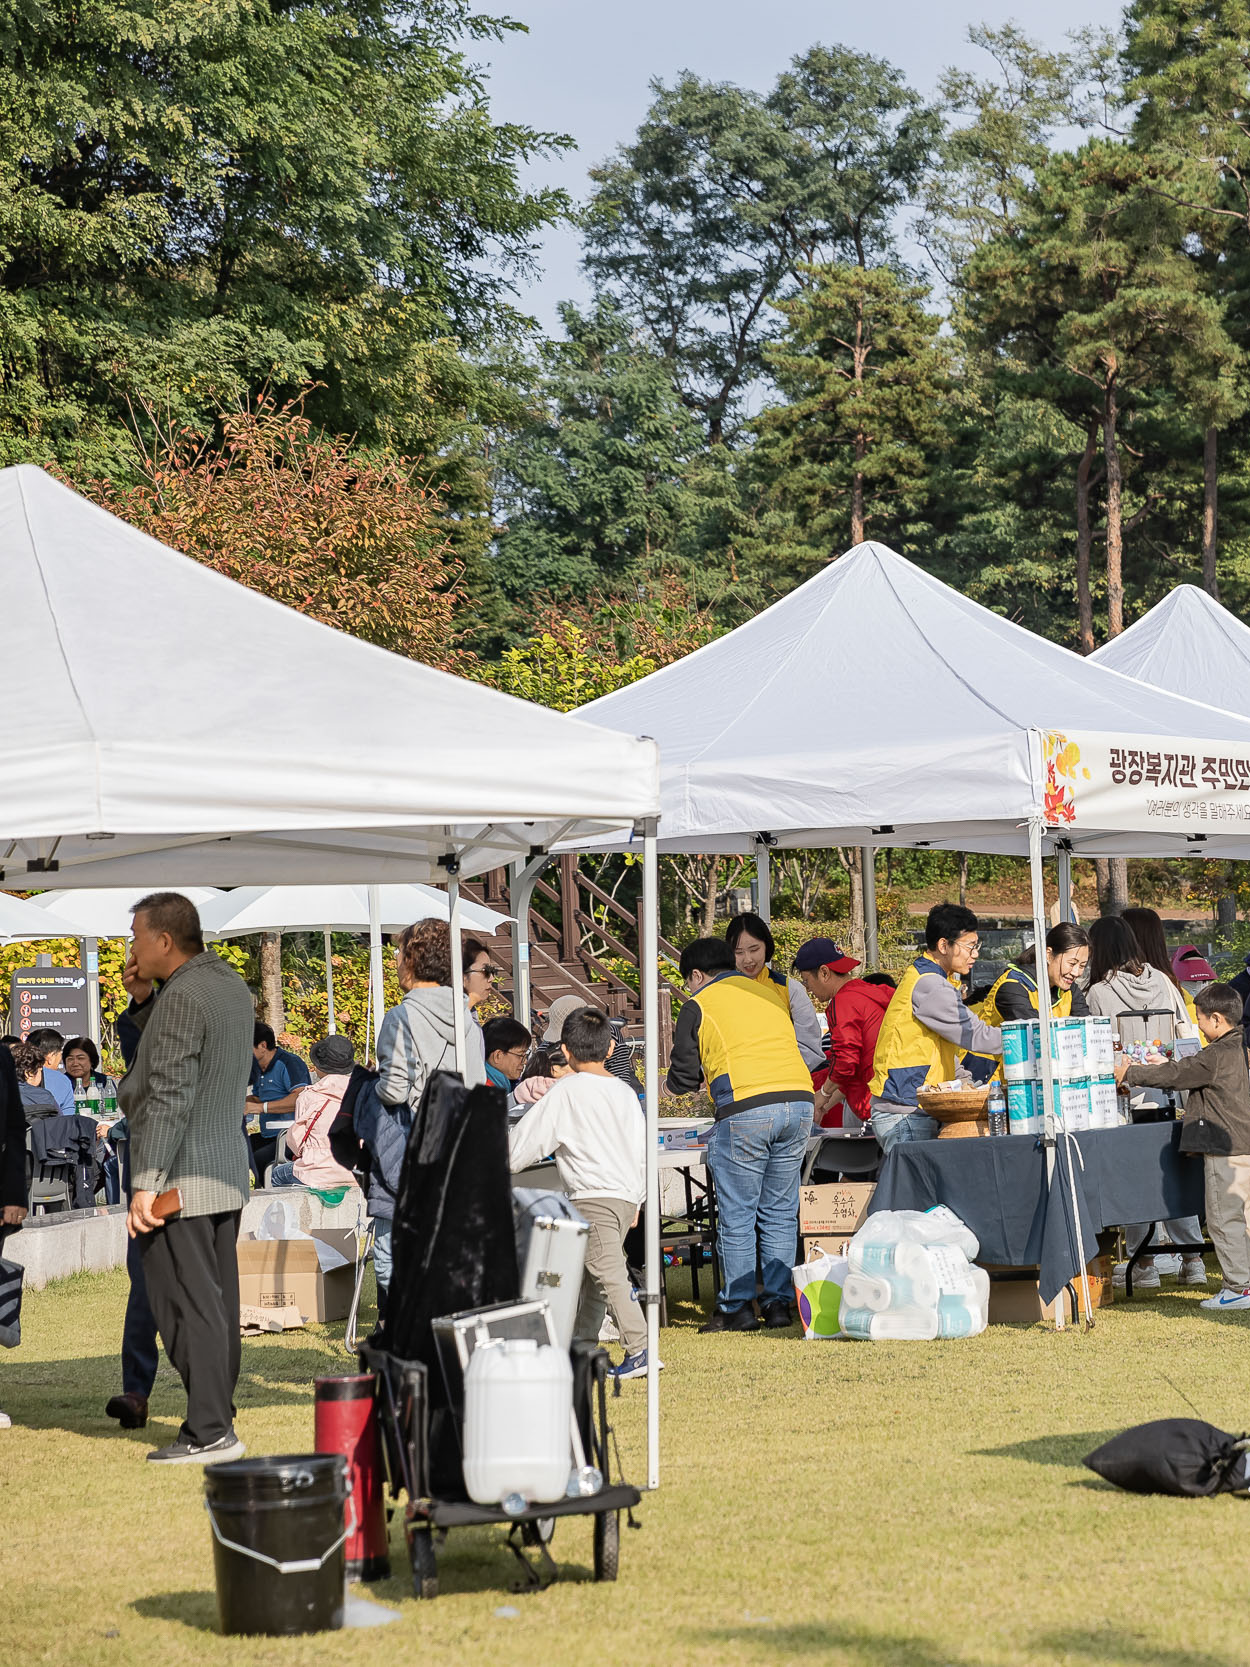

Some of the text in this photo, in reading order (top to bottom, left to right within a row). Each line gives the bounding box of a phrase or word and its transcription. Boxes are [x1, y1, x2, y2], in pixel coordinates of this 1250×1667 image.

[1109, 748, 1198, 788] 광장복지관
[1183, 801, 1208, 820] 생각을
[832, 1195, 855, 1208] 옥수수
[833, 1207, 855, 1218] 수염차
